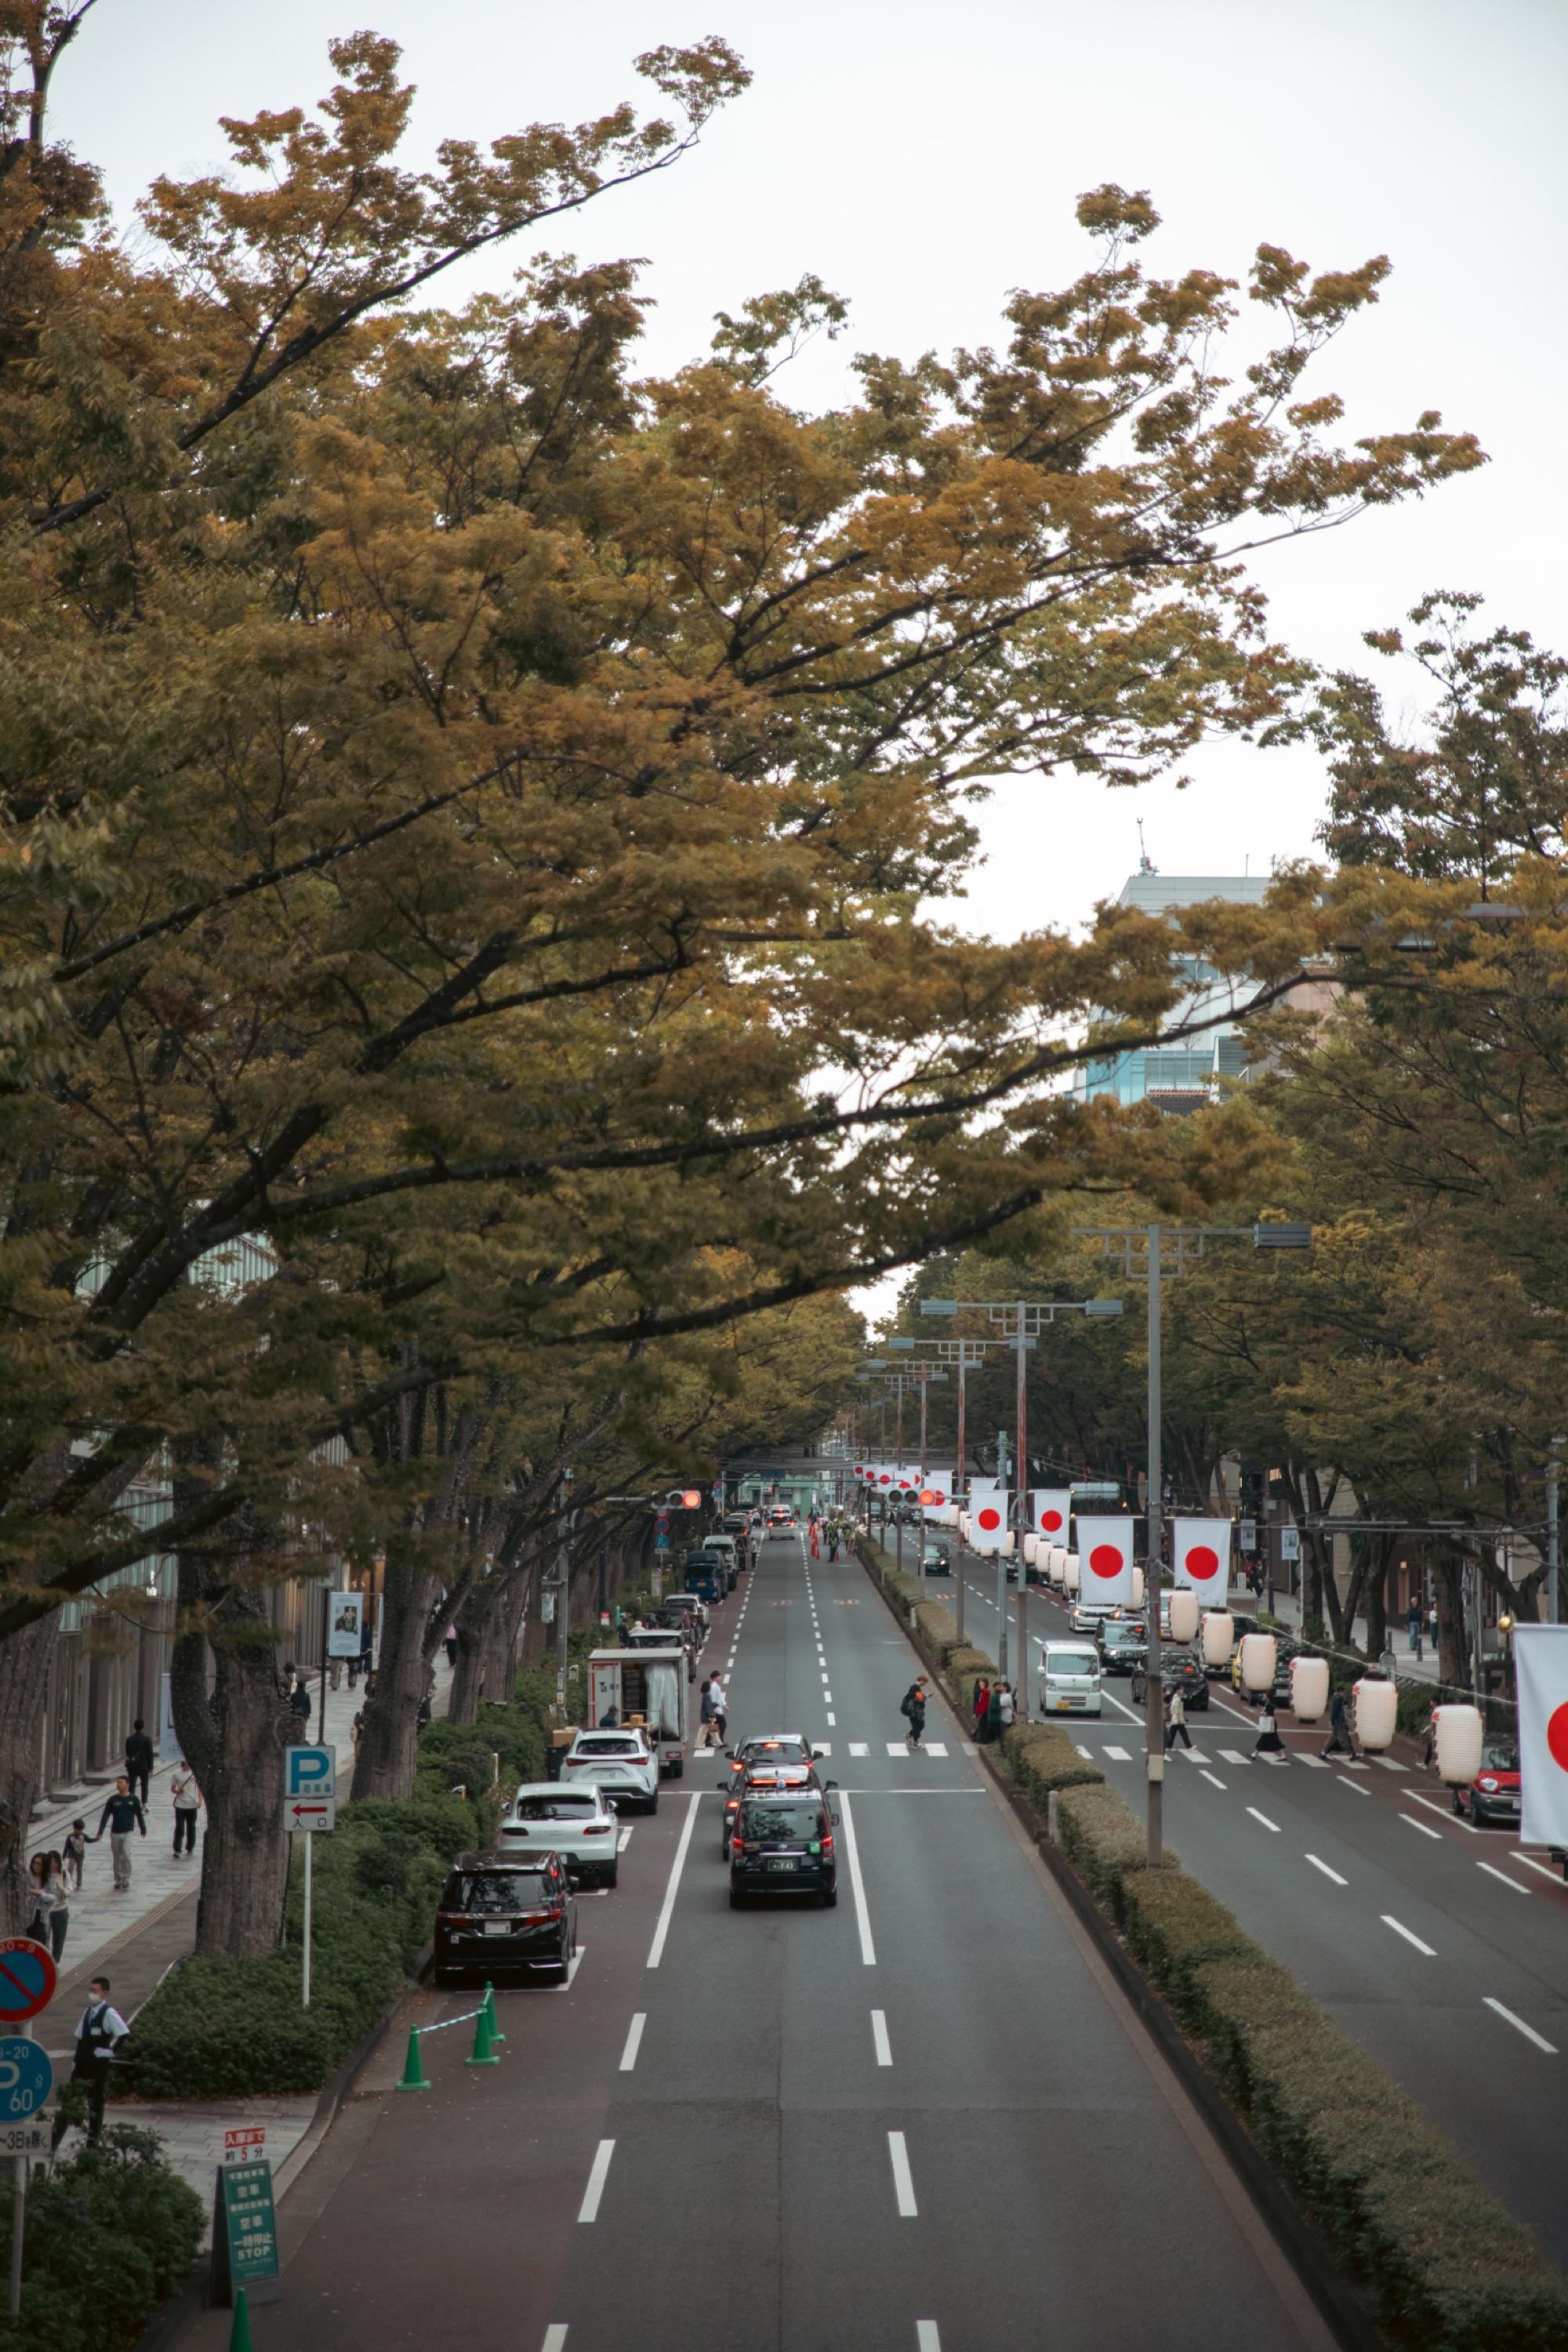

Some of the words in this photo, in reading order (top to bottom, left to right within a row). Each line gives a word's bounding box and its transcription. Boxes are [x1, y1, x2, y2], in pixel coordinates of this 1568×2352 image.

[291, 1751, 329, 1794] P
[10, 2088, 33, 2113] 60
[238, 2245, 270, 2259] STOP
